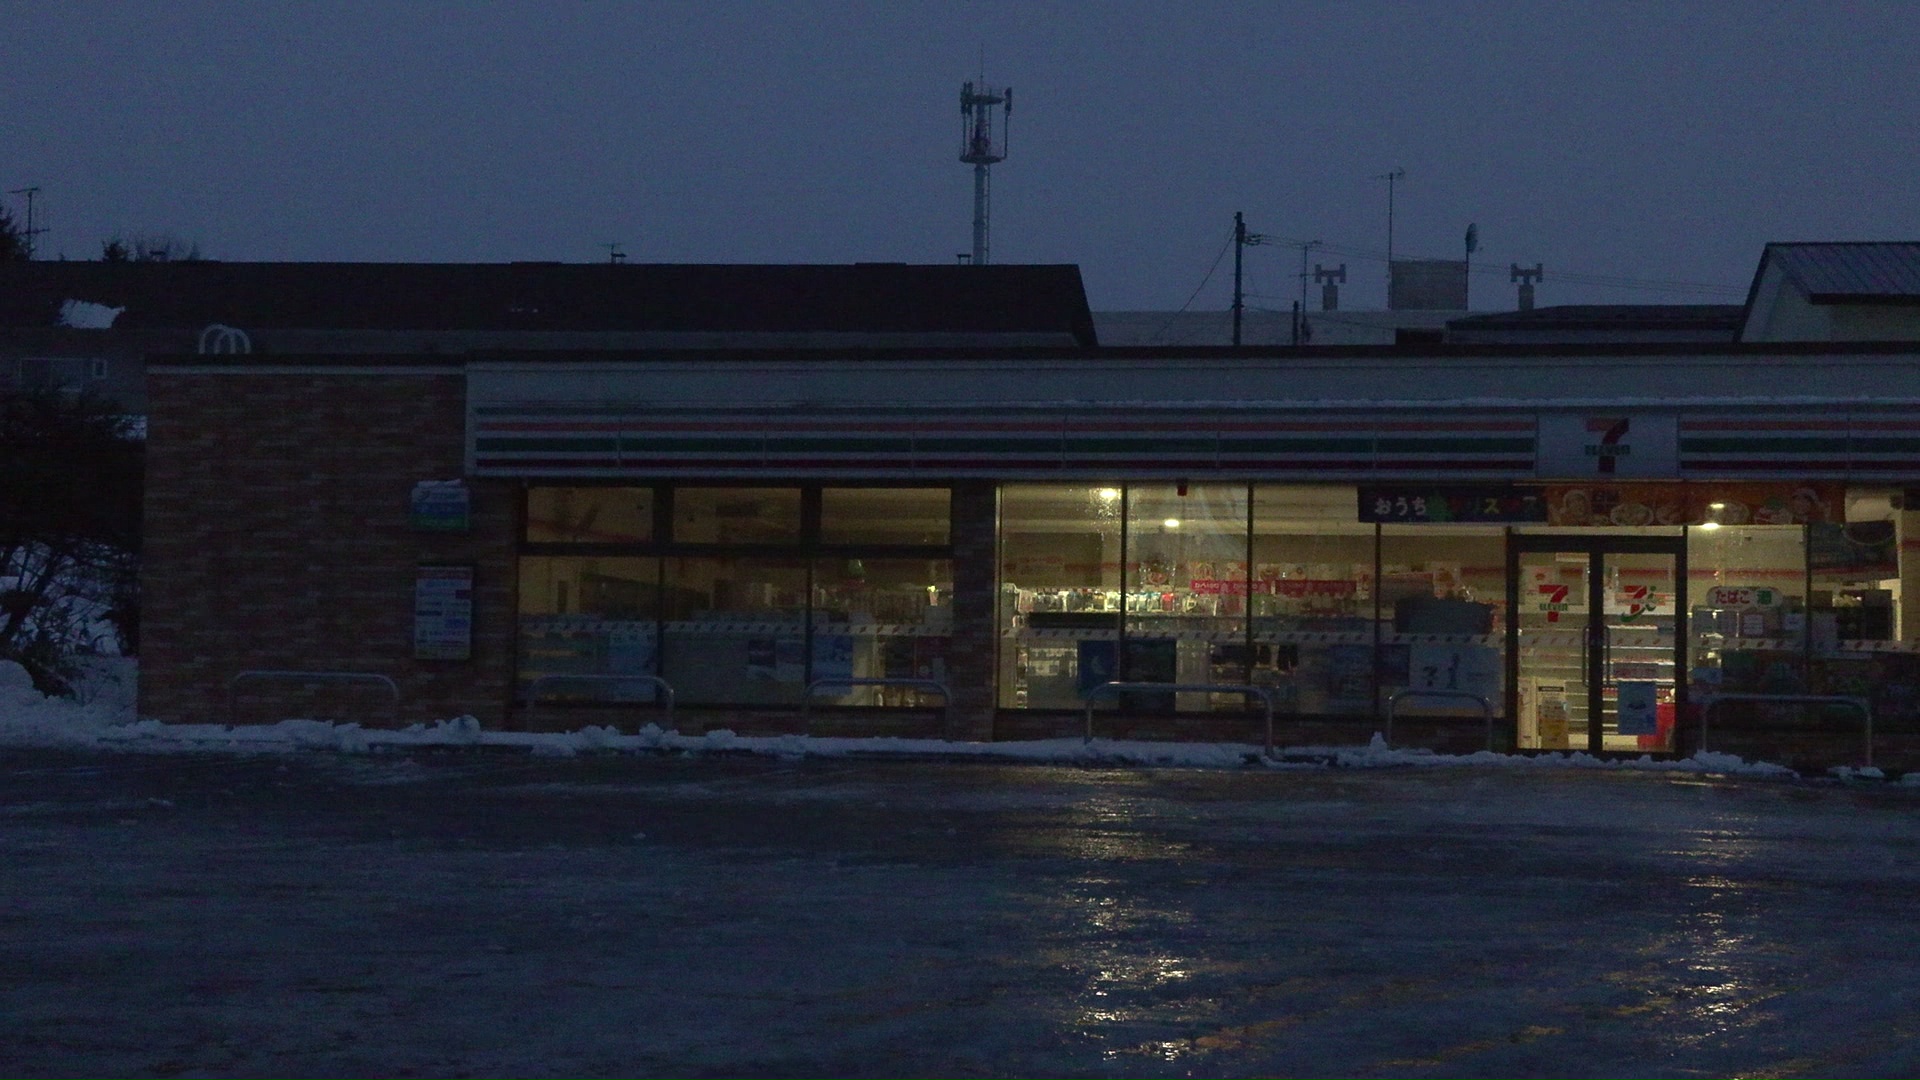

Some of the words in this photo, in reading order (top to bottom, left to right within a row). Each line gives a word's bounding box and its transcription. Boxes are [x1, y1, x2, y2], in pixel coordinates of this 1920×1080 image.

[1585, 417, 1630, 473] 7
[1539, 585, 1568, 622] 7
[1715, 589, 1750, 604] たばこ
